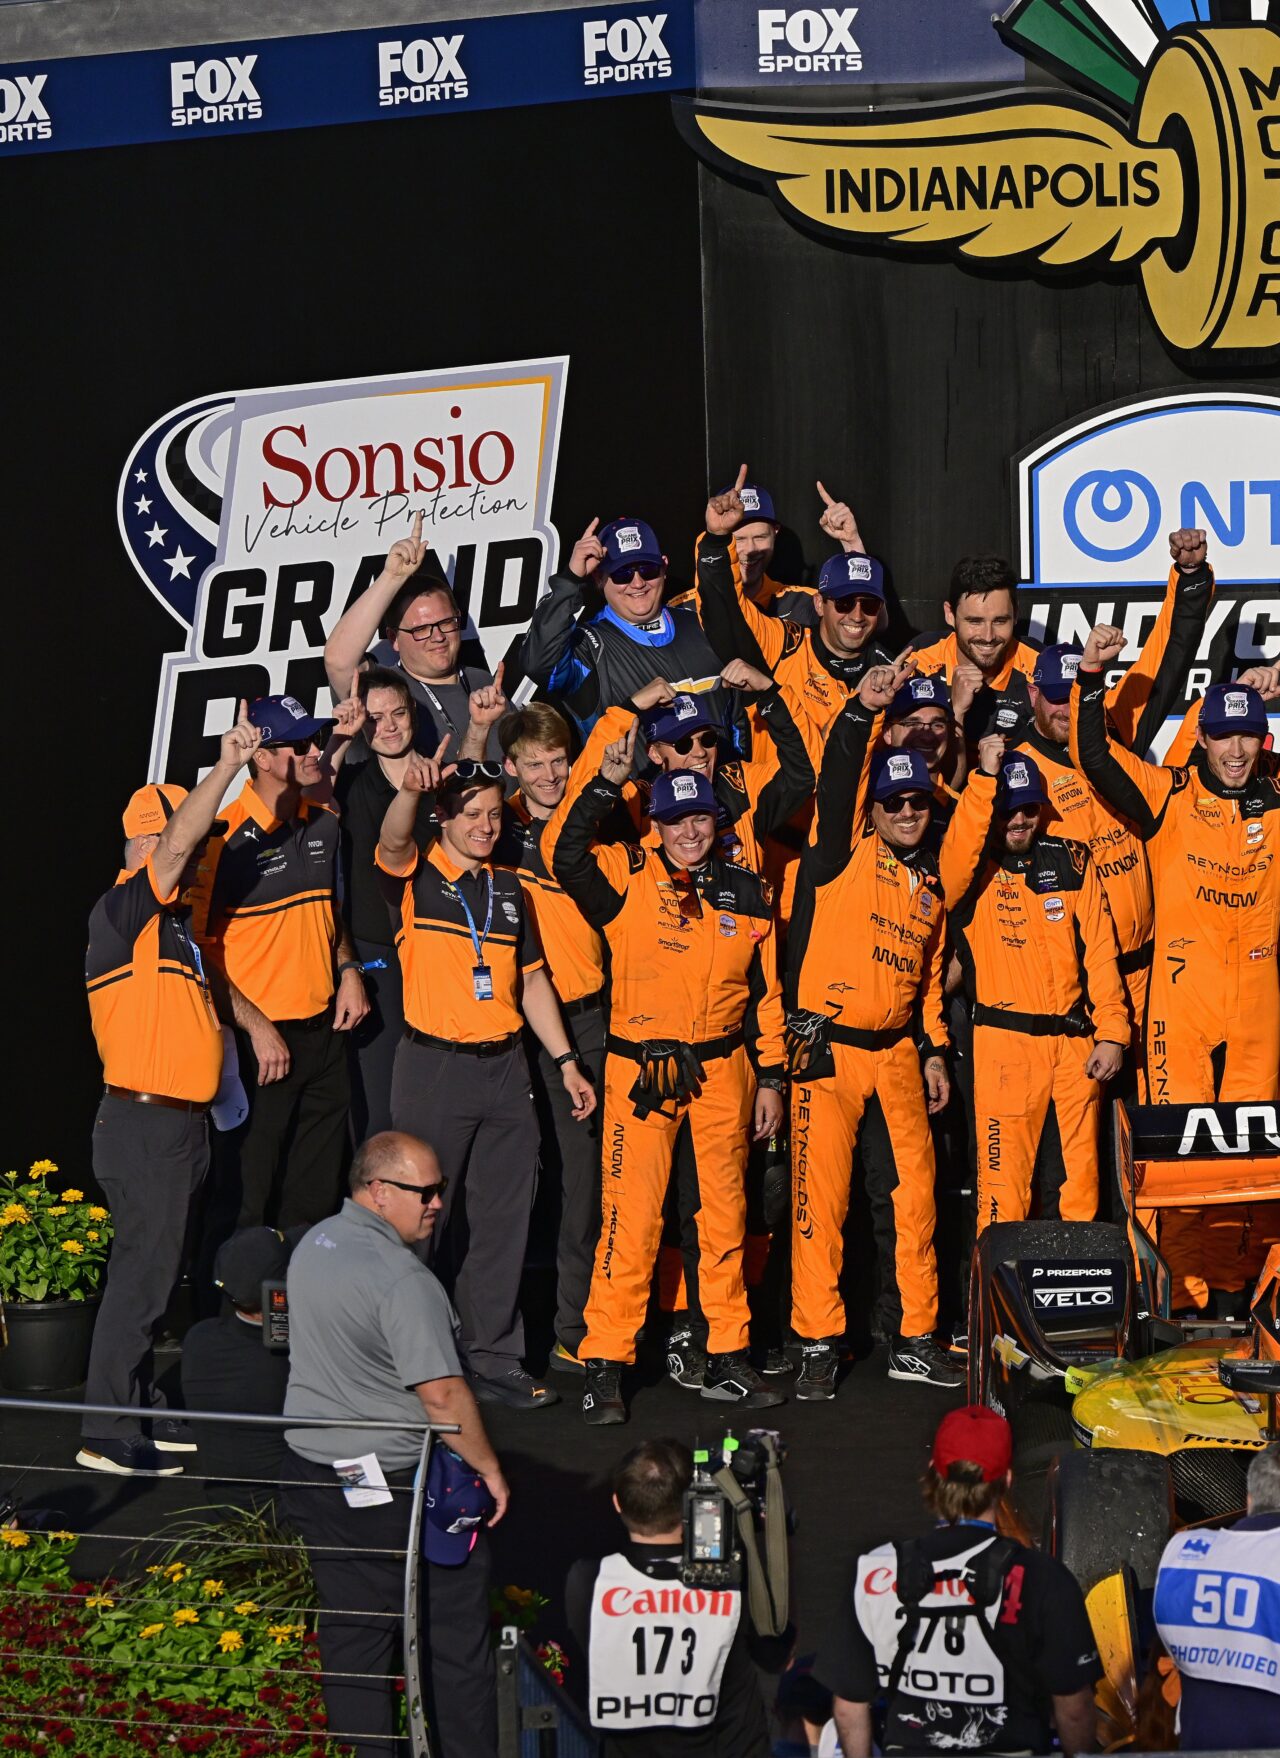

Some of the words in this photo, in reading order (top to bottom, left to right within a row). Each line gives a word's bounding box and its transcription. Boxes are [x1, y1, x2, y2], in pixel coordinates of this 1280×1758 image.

[584, 14, 670, 66] FOX
[759, 8, 861, 54] FOX
[379, 35, 466, 87] FOX
[585, 60, 671, 85] SPORTS
[759, 54, 862, 72] SPORTS
[171, 55, 260, 107] FOX
[379, 81, 468, 105] SPORTS
[172, 102, 262, 126] SPORTS
[825, 161, 1161, 213] INDIANAPOLIS
[262, 406, 515, 509] Sonsio
[245, 501, 358, 553] Vehicle
[370, 483, 527, 536] Protection
[1058, 787, 1083, 803] ARROW
[1187, 854, 1270, 878] REYNOLDS
[1196, 886, 1258, 908] ARROW
[870, 912, 929, 947] REYNOLDS
[872, 946, 918, 974] ARROW
[1167, 956, 1186, 984] 7
[611, 1123, 624, 1178] ARROW
[796, 1087, 813, 1223] REYNOLDS
[988, 1118, 1001, 1172] ARROW
[602, 1203, 618, 1272] McLaren
[1046, 1268, 1112, 1277] PRIZEPICKS
[1035, 1291, 1112, 1307] VELO
[1183, 1433, 1266, 1447] Firesto
[602, 1587, 733, 1617] Canon
[1192, 1574, 1260, 1628] 50
[632, 1626, 696, 1676] 173
[1170, 1644, 1279, 1677] PHOTO/VIDEO
[597, 1693, 717, 1720] PHOTO
